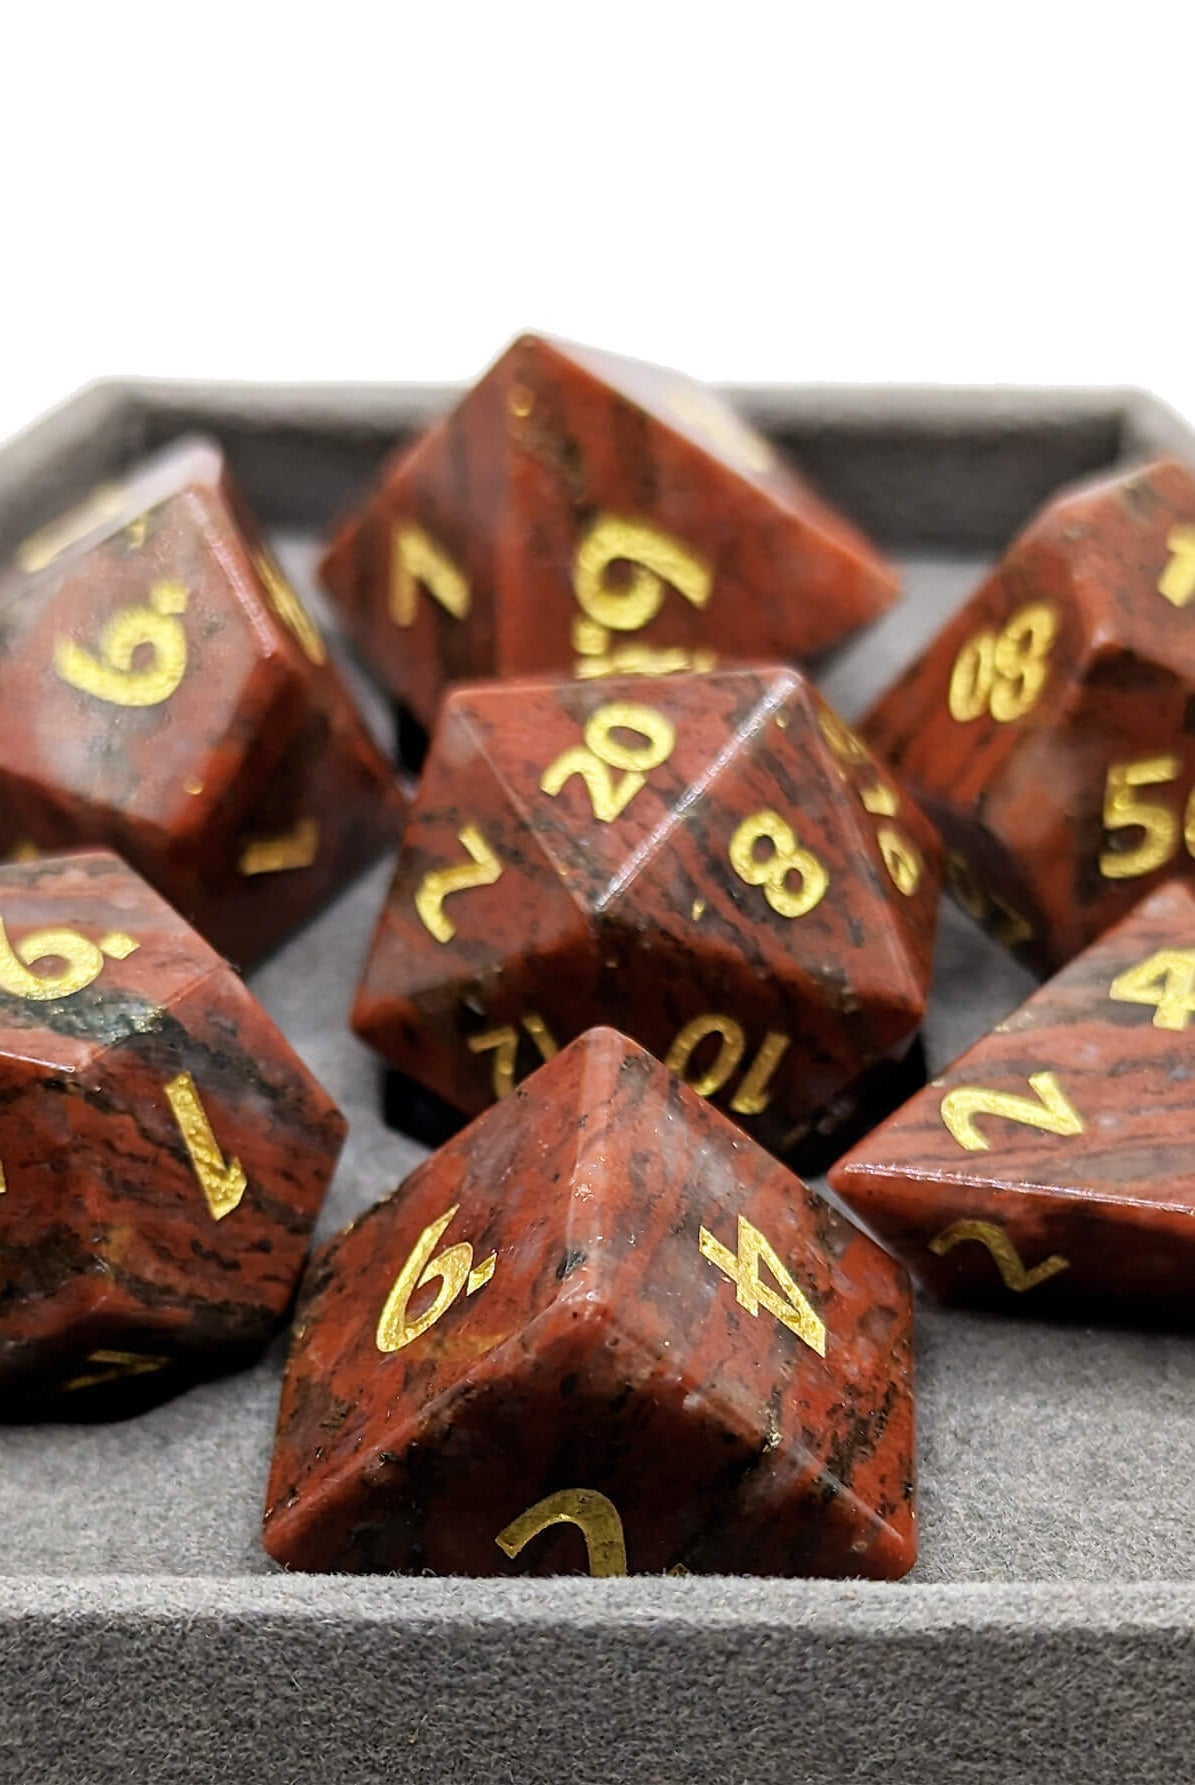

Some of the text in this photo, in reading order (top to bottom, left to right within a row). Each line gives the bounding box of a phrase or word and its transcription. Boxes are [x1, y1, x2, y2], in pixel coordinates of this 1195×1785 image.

[540, 703, 675, 823] 20
[729, 810, 829, 918] 8
[941, 1072, 1084, 1151] 2
[699, 1215, 827, 1358] 4
[928, 1219, 1071, 1292] 2
